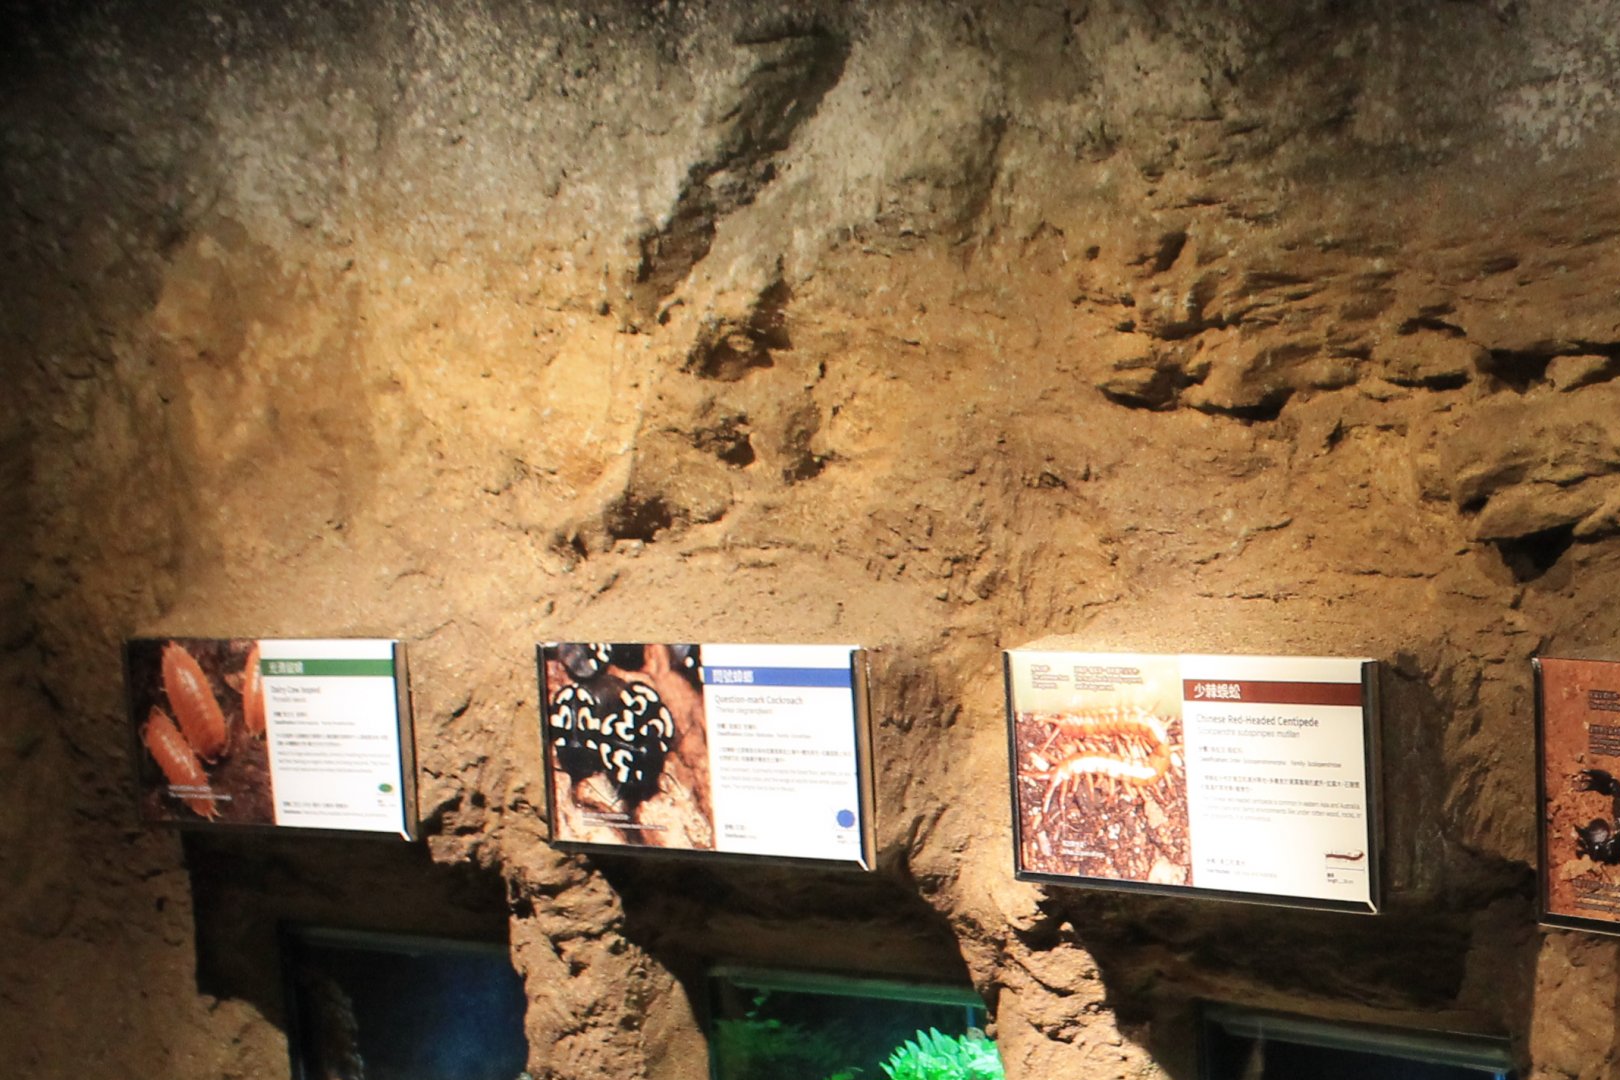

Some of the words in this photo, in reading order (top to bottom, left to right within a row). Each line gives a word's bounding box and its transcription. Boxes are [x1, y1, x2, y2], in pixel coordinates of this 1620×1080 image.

[1194, 682, 1241, 699] 少棘蜈蚣
[715, 695, 765, 705] Question-mark
[766, 696, 803, 705] Cockroach
[1197, 713, 1226, 724] Chinese
[1227, 714, 1276, 725] Red-Headed
[1277, 716, 1319, 728] Centipede
